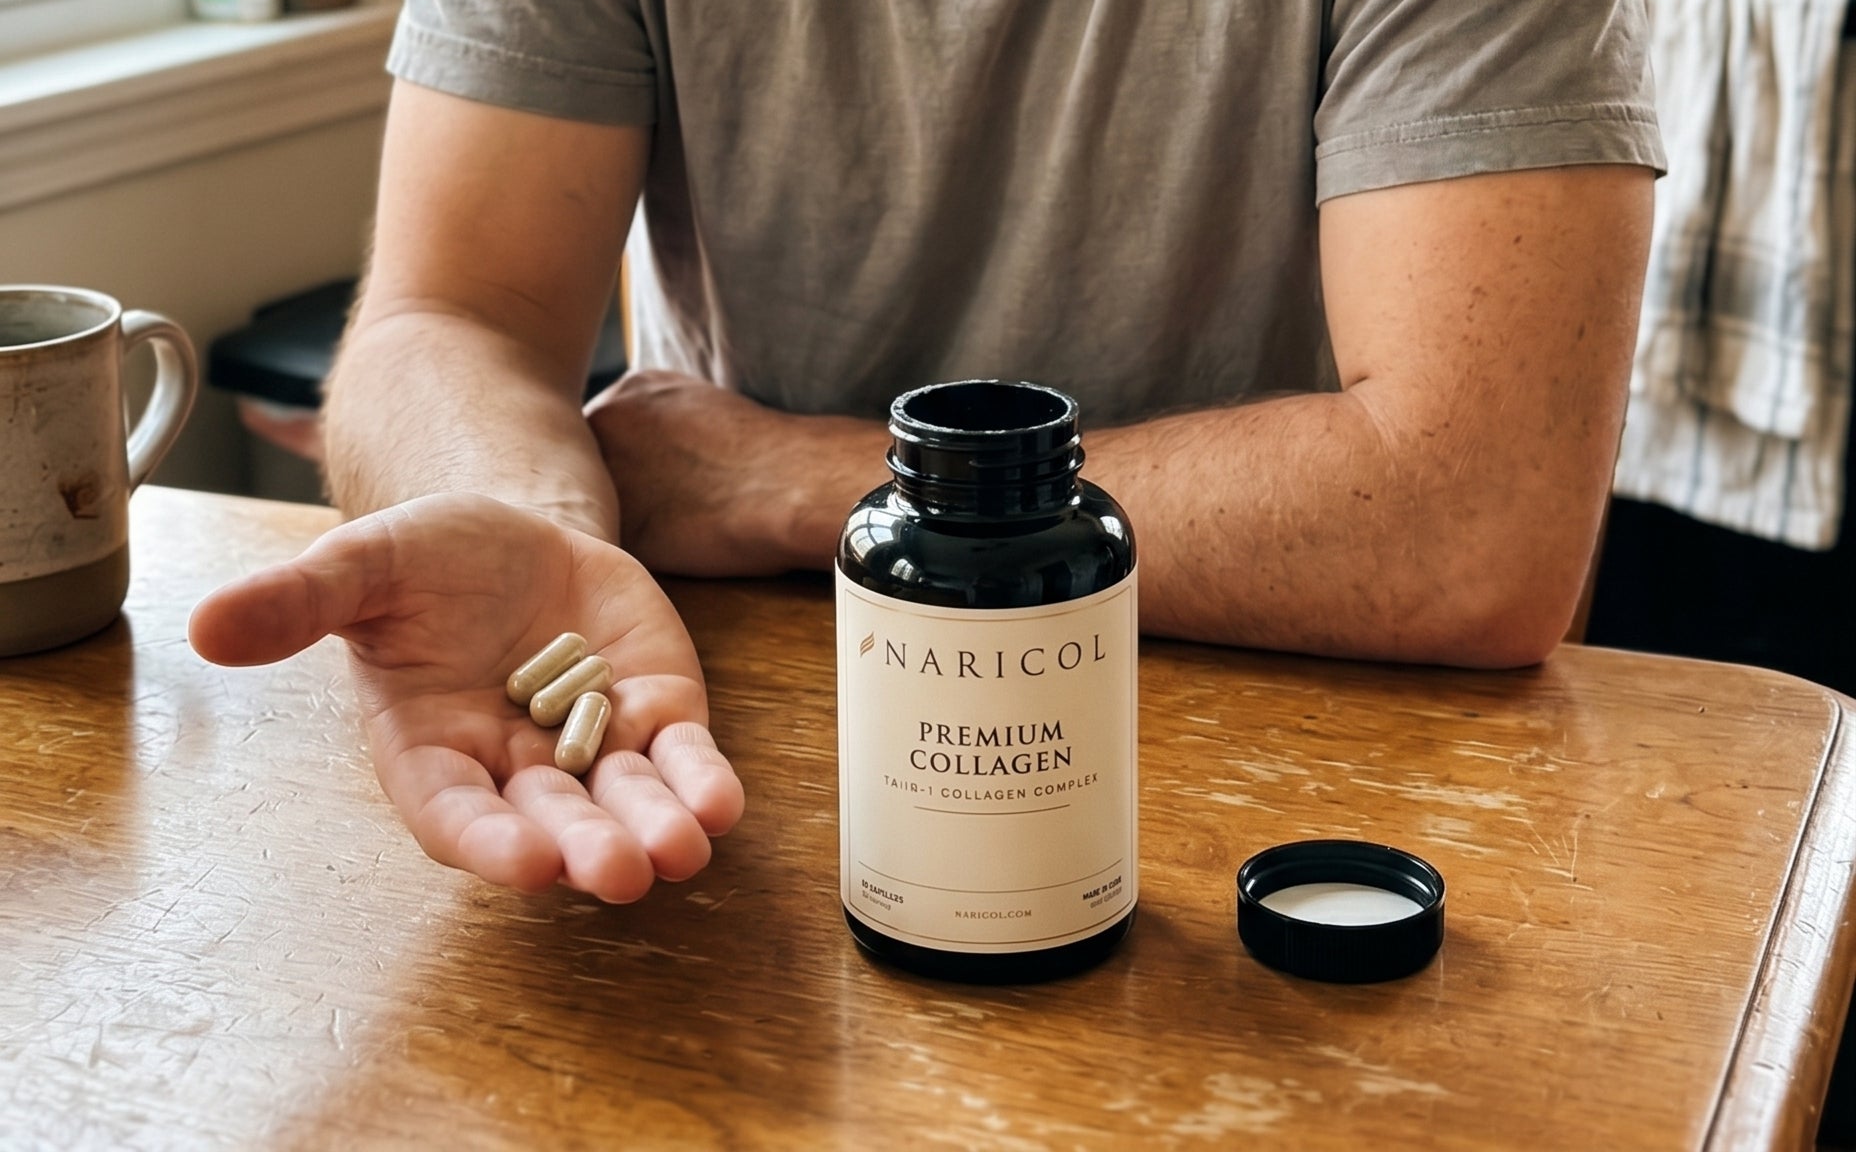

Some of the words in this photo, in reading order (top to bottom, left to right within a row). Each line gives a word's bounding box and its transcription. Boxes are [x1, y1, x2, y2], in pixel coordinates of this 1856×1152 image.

[885, 634, 1106, 679] NARICOL
[919, 720, 1064, 747] PREMIUM
[910, 746, 1072, 776] COLLAGEN
[941, 787, 1026, 801] COLLAGEN
[1034, 772, 1098, 797] COMPLEX
[955, 909, 1032, 920] NARICOL.COM
